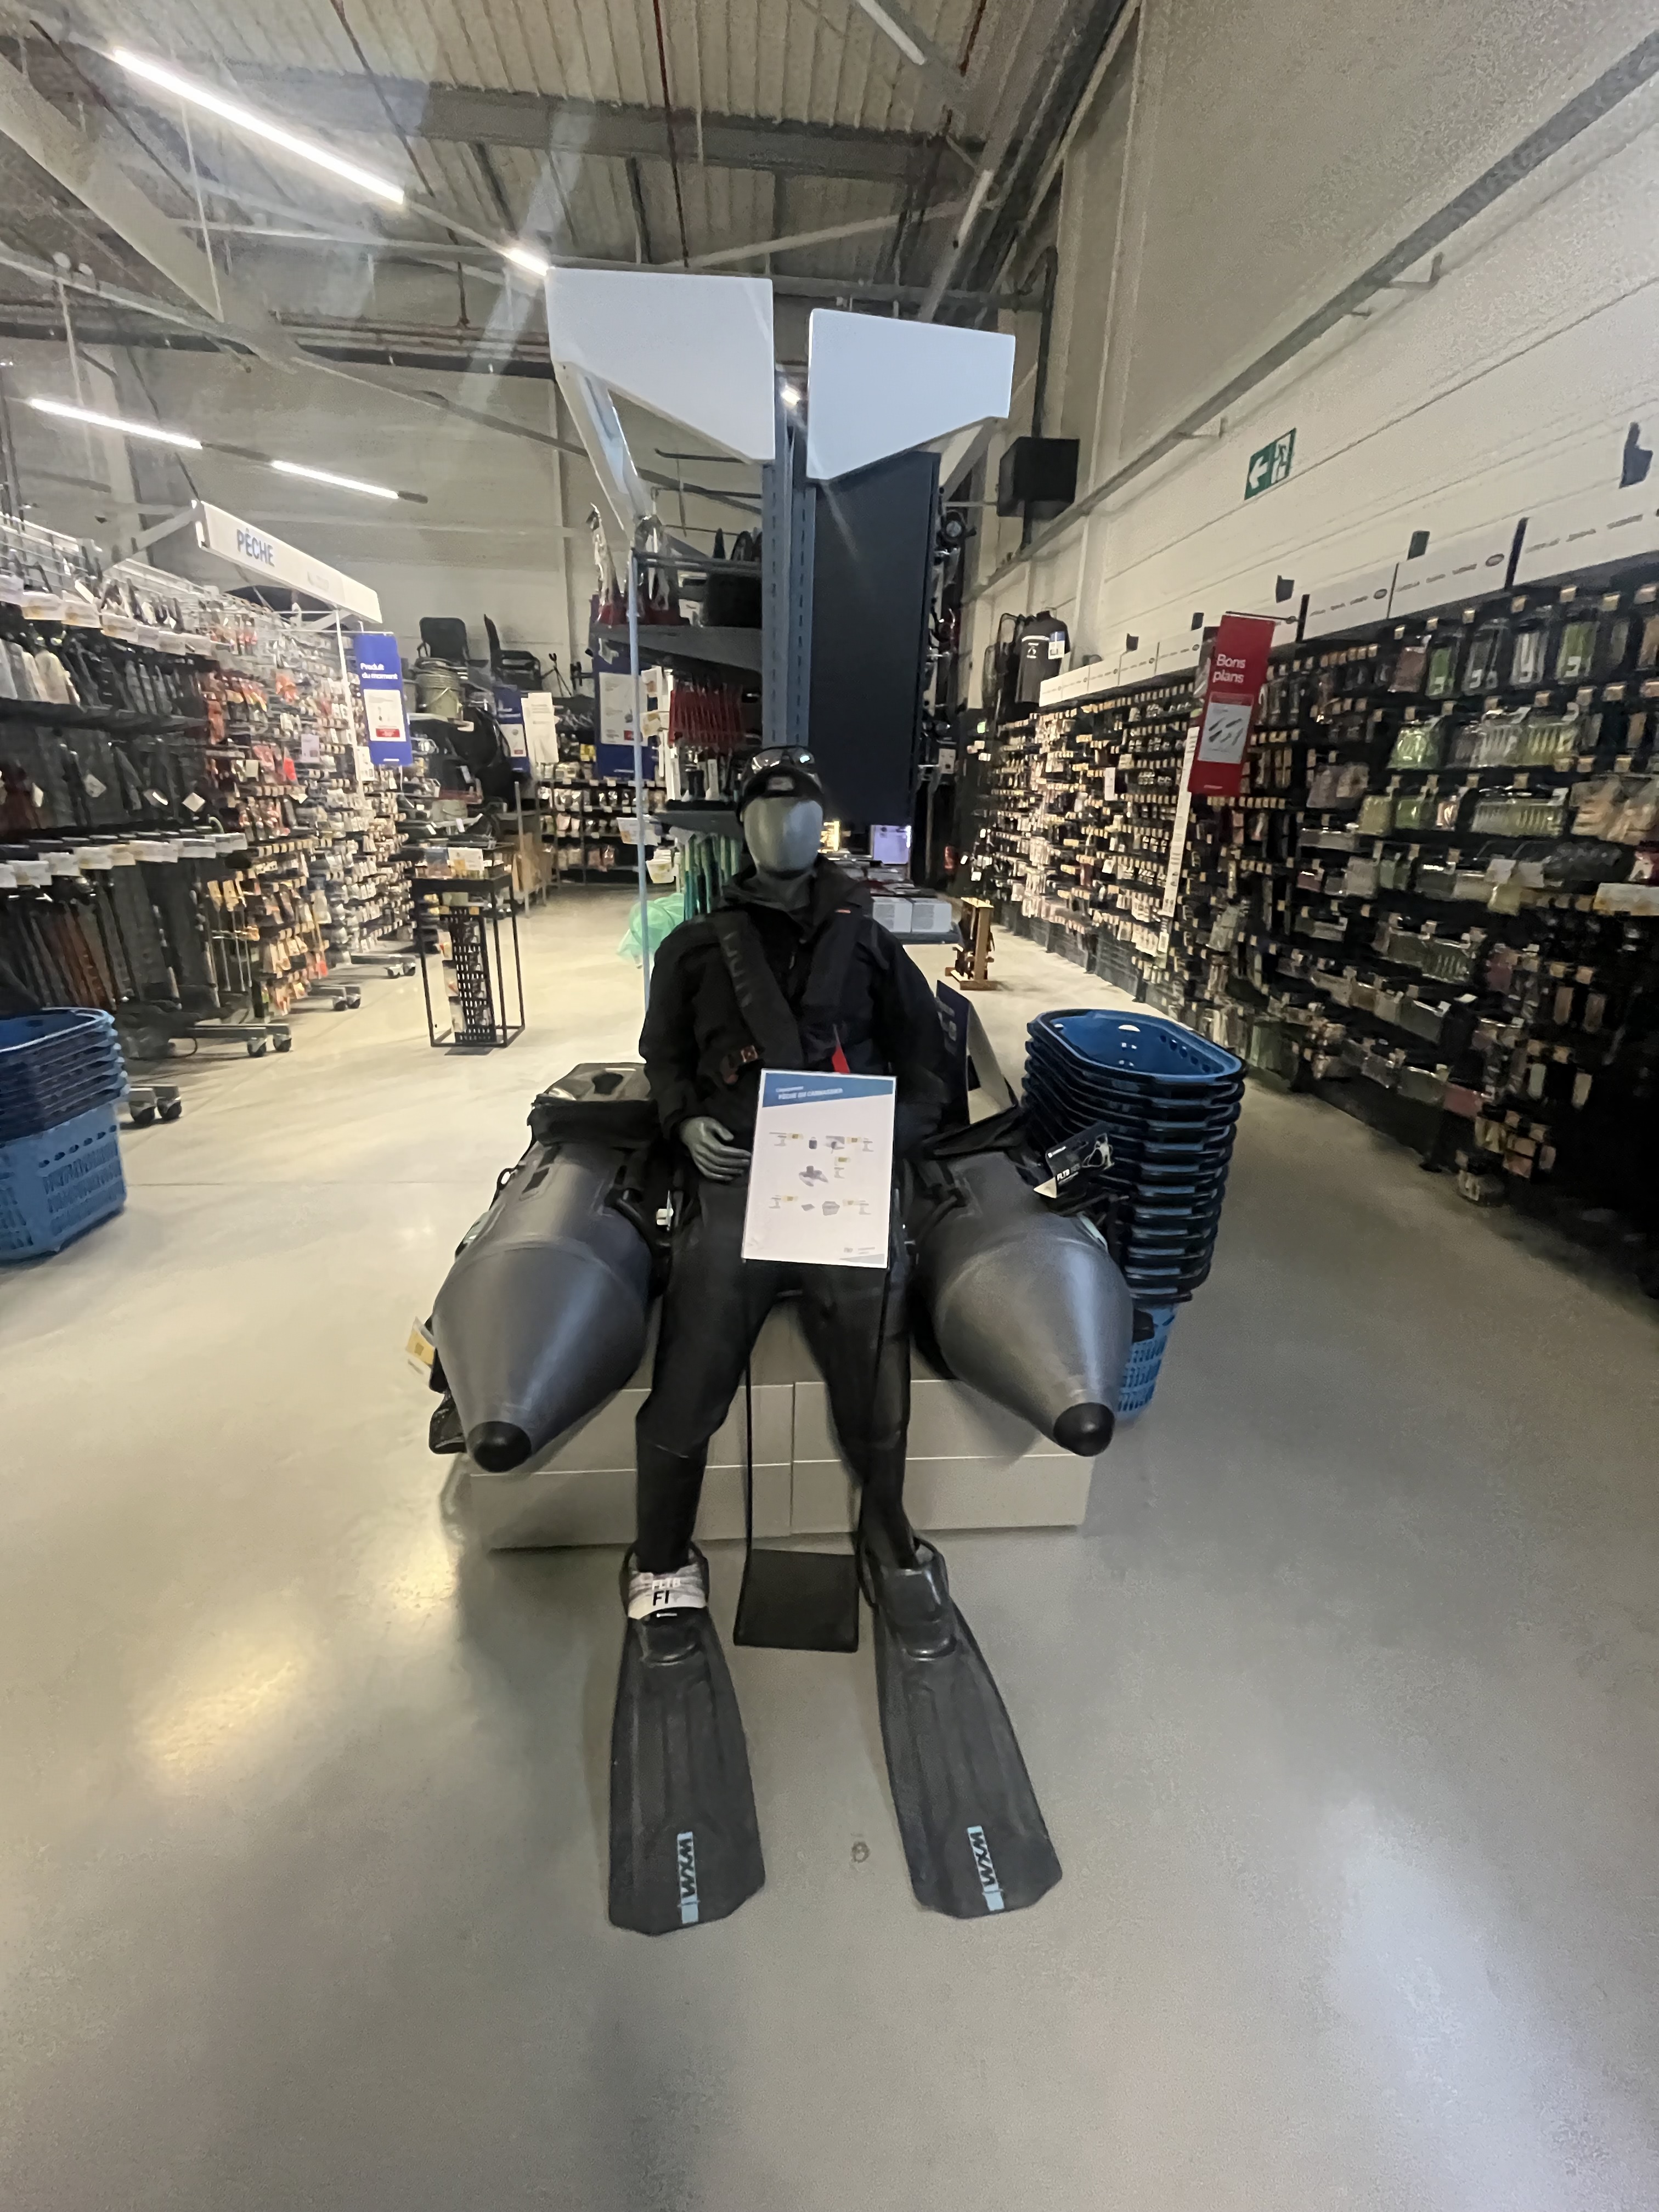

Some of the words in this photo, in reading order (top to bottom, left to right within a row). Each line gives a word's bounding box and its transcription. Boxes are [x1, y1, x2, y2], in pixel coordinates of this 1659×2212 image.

[236, 528, 275, 567] PÊCHE
[360, 662, 385, 670] Produit
[1216, 653, 1246, 669] Bons
[1212, 669, 1245, 684] plans
